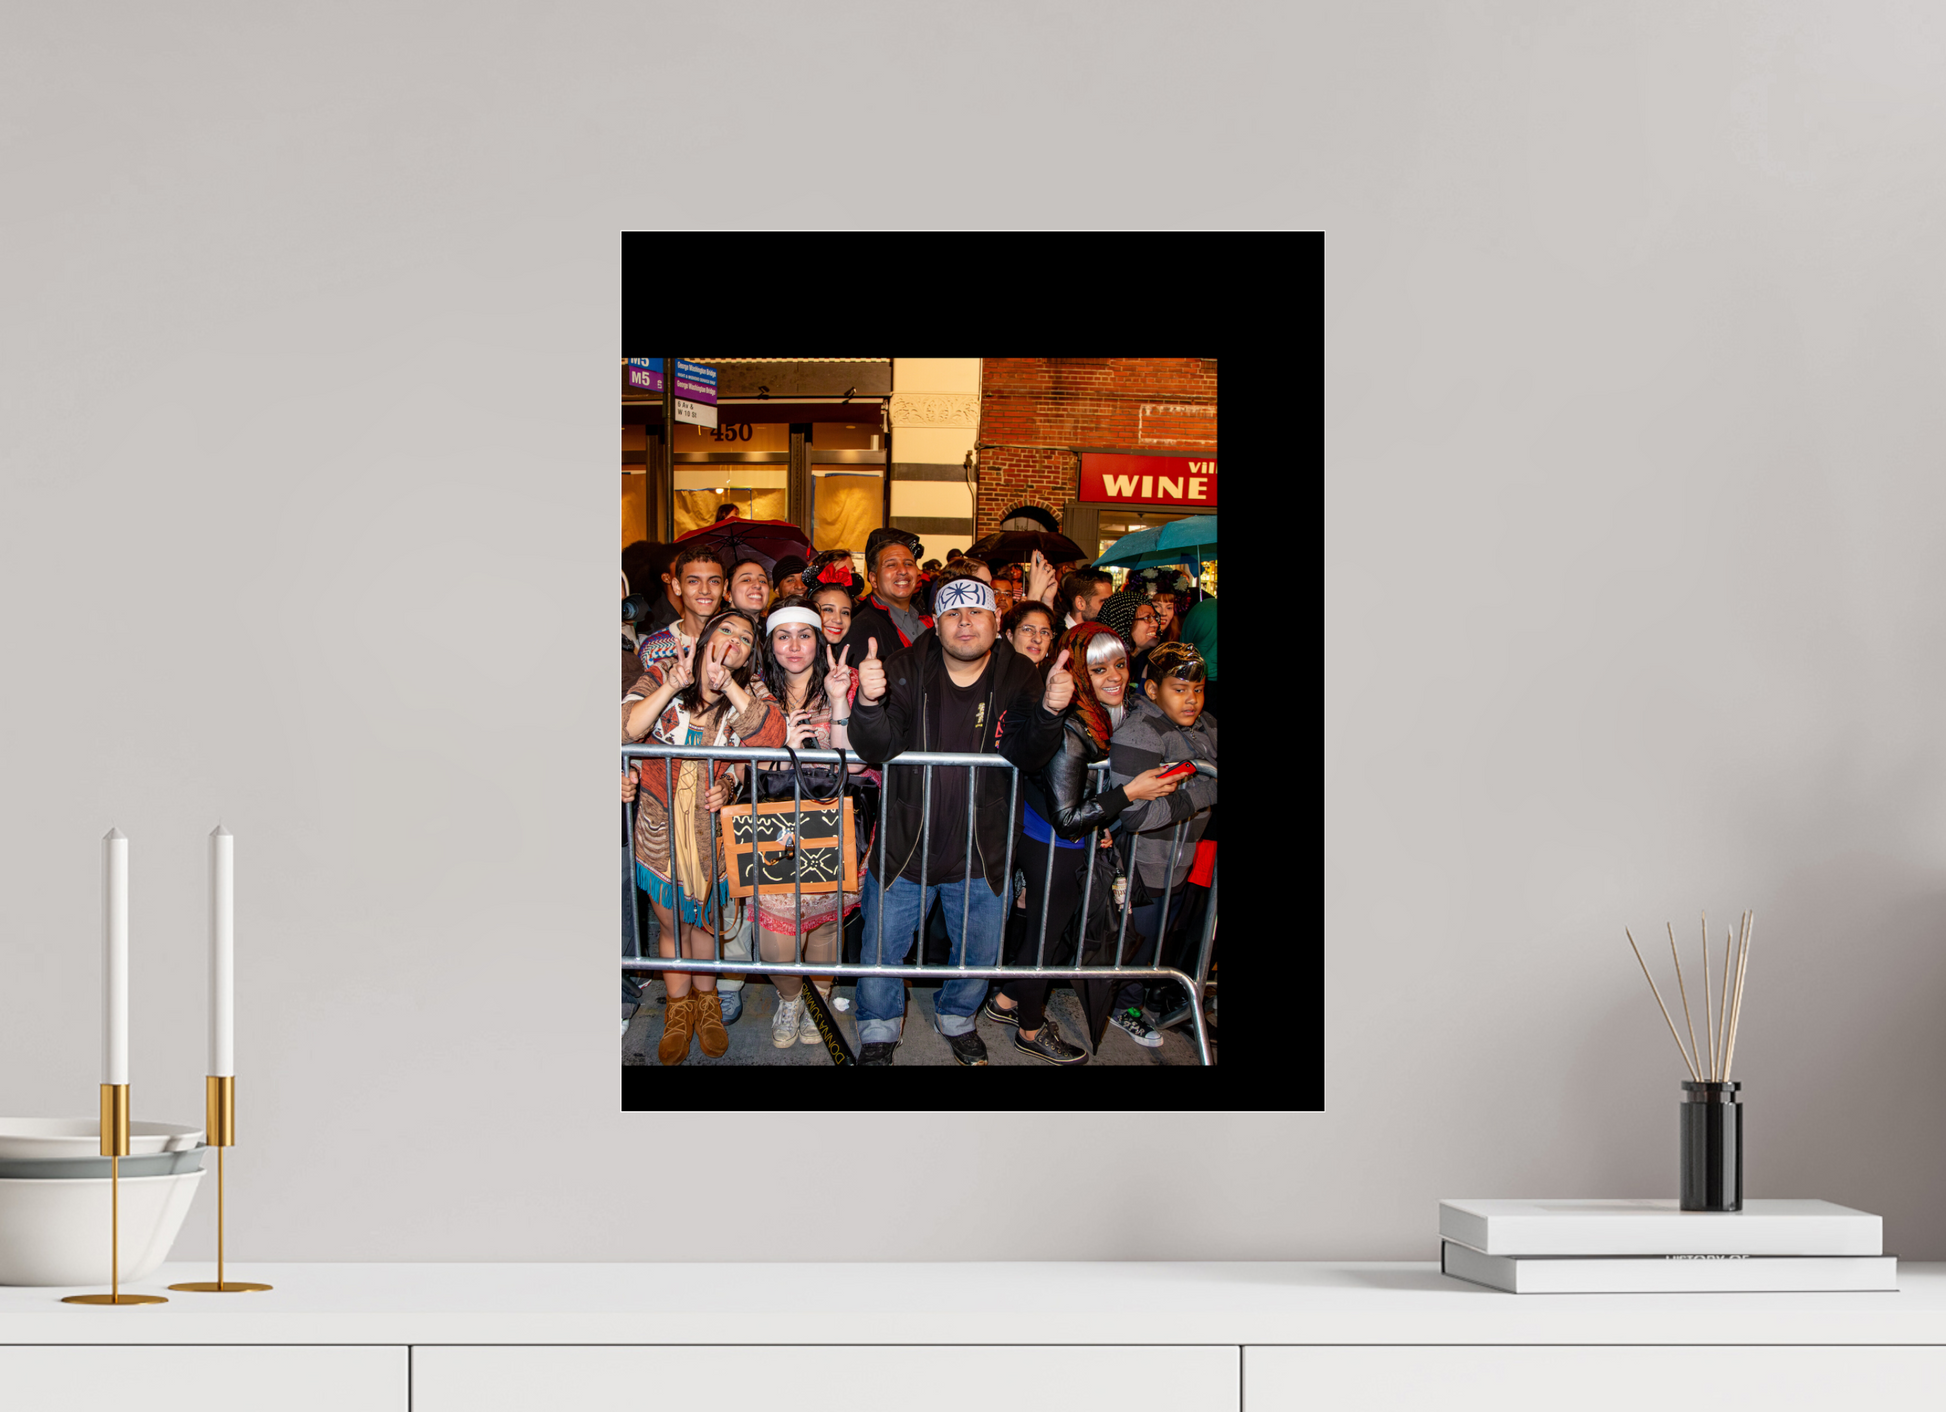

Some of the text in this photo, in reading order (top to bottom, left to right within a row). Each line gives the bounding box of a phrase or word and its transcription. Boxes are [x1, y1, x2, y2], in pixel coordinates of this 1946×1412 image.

[631, 358, 650, 367] M5
[631, 371, 650, 386] M5
[710, 423, 753, 442] 450
[1188, 462, 1218, 474] Vil
[1102, 474, 1208, 499] WINE
[819, 1019, 845, 1065] DONNA
